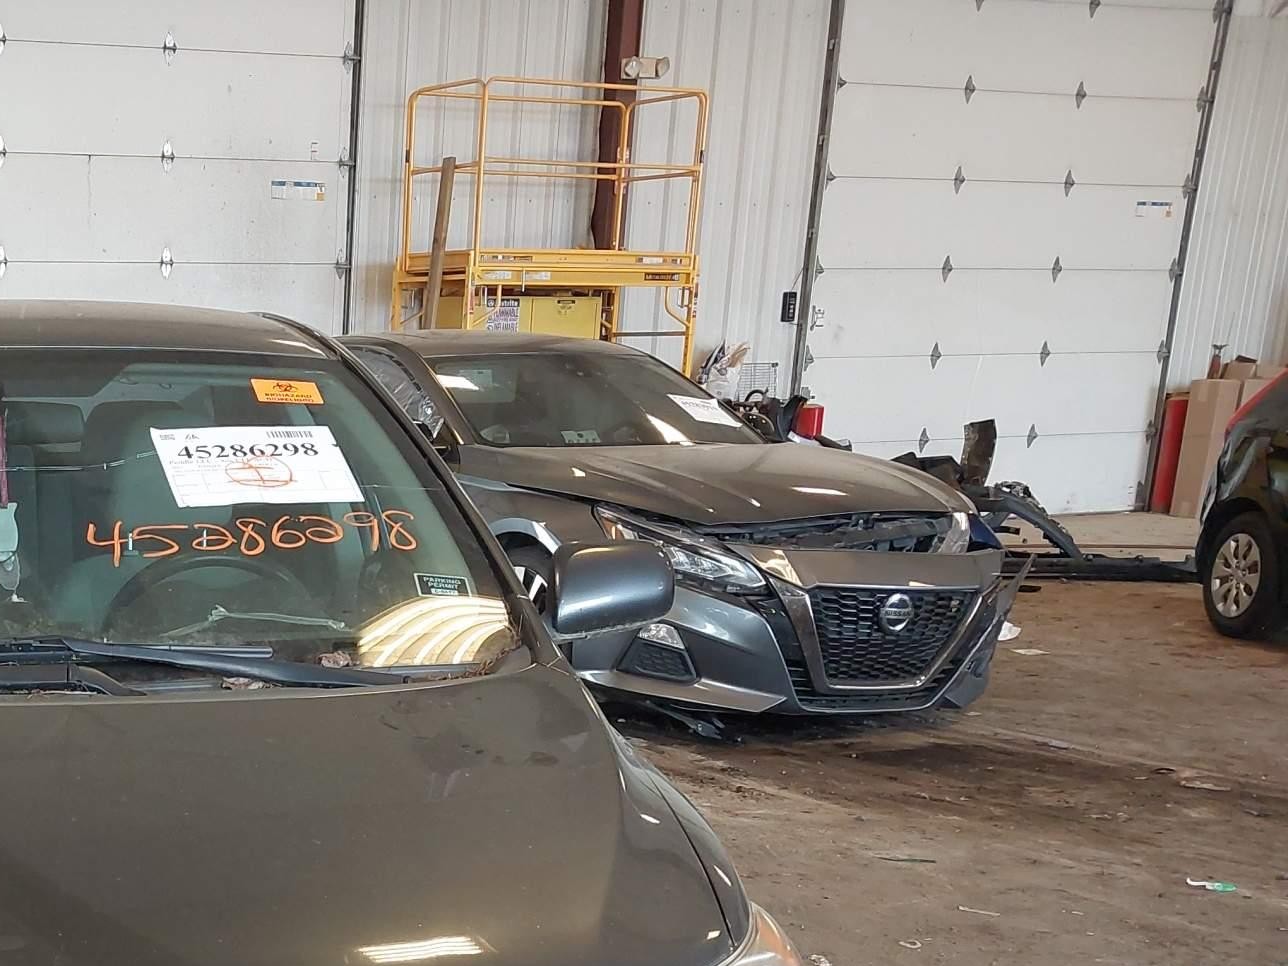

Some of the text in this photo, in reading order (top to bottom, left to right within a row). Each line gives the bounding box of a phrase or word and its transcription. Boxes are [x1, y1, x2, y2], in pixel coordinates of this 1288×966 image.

[178, 443, 319, 459] 45286298
[87, 511, 417, 568] 45286298
[423, 576, 461, 585] PARKING
[428, 582, 458, 590] PERMIT
[884, 609, 911, 617] NISSAN
